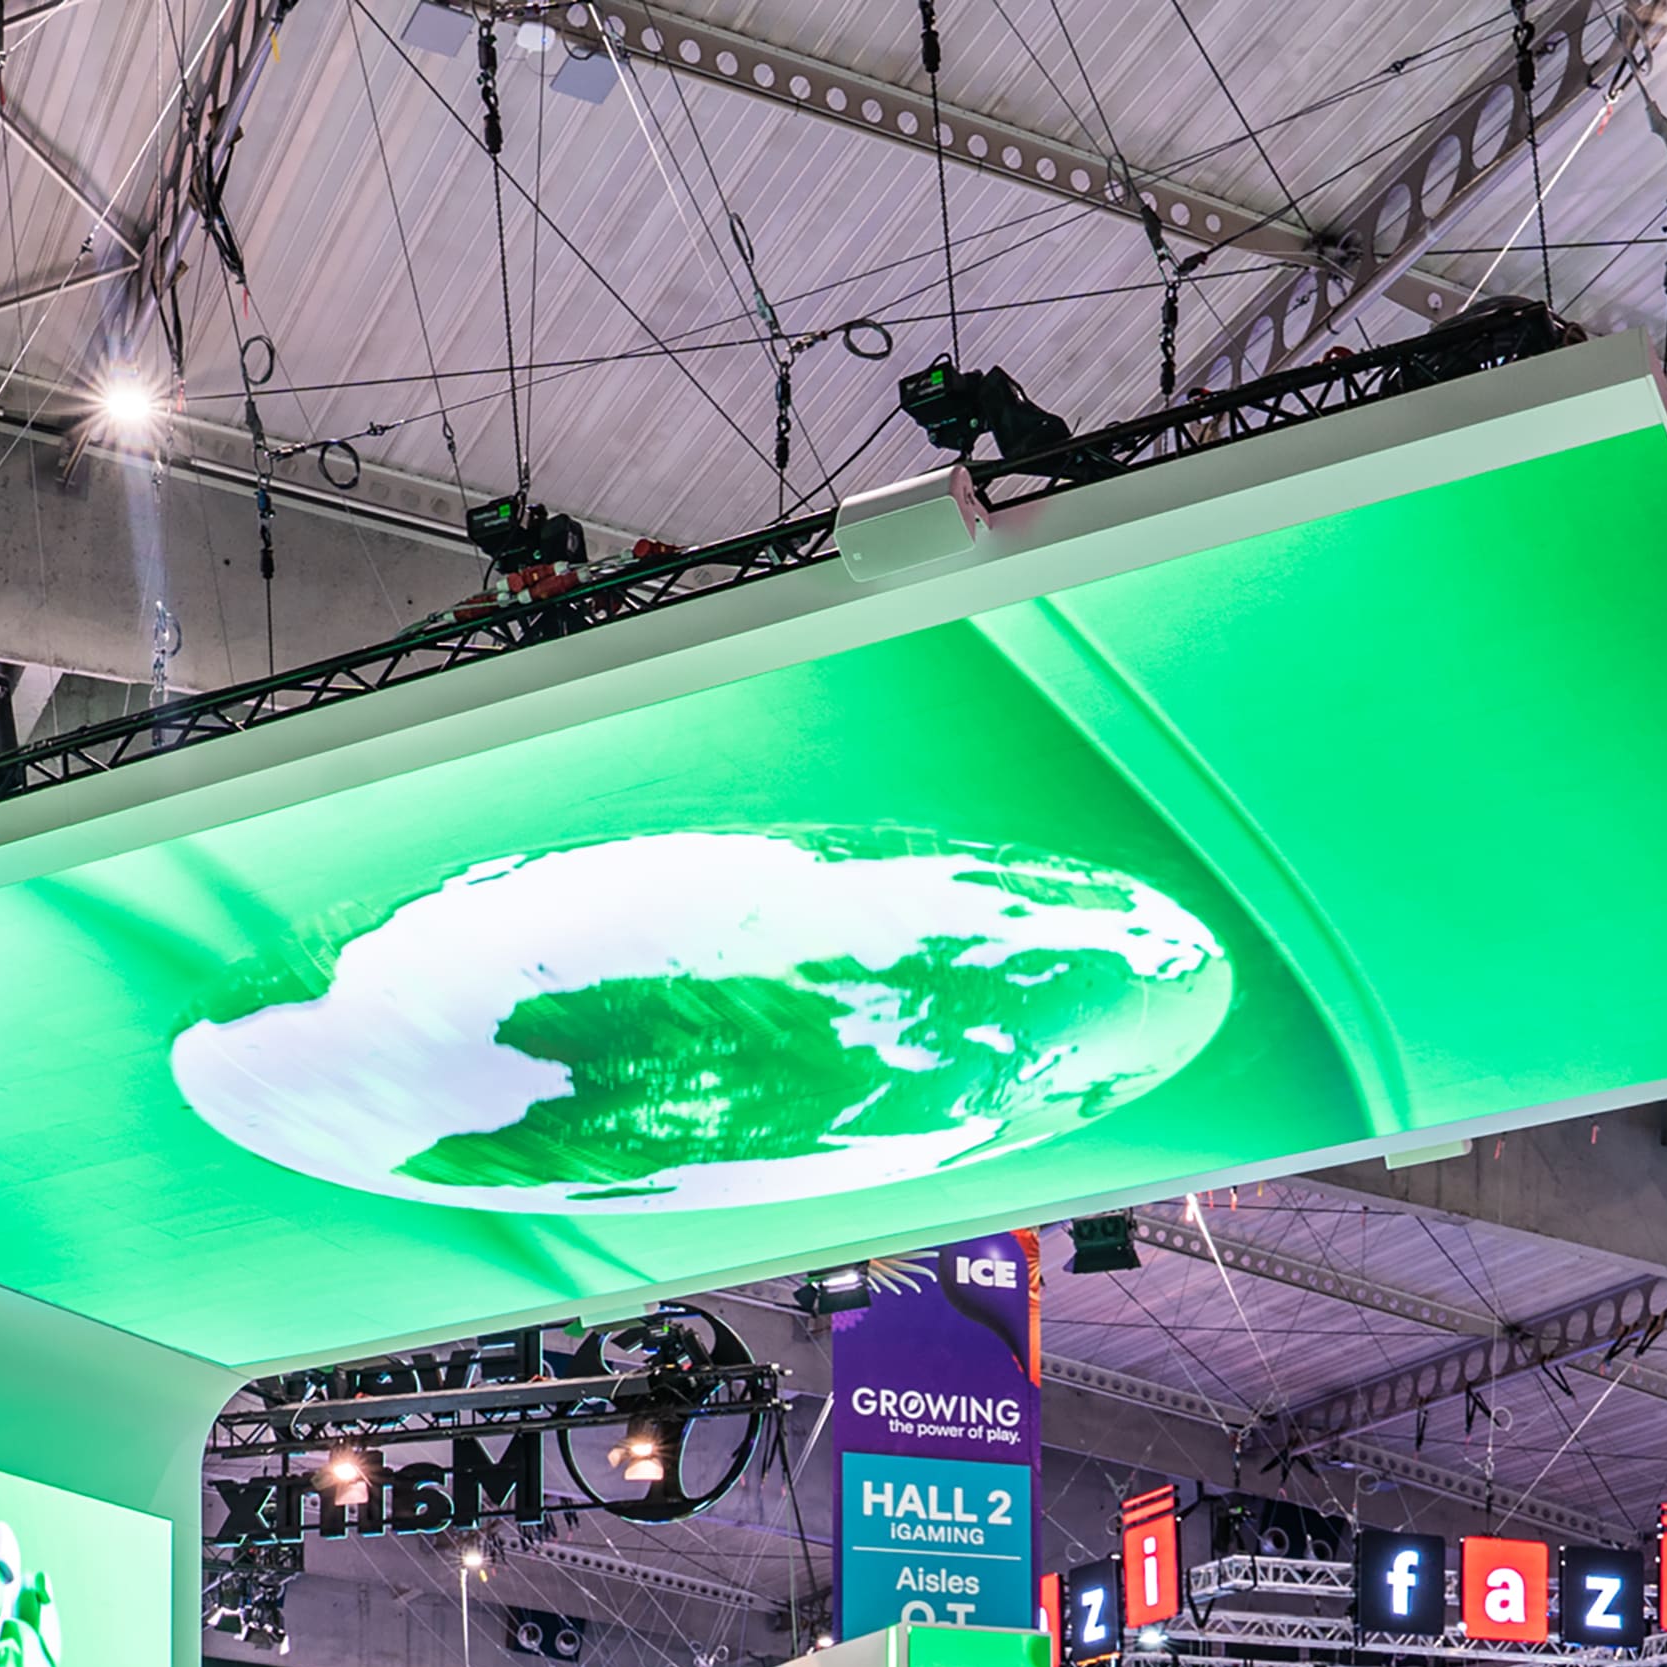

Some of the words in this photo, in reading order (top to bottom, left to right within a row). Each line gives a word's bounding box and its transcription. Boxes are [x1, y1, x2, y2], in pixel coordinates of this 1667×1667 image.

[956, 1256, 1017, 1289] ICE
[852, 1386, 1021, 1427] GROWING
[889, 1418, 914, 1434] the
[917, 1423, 965, 1438] power
[967, 1424, 984, 1439] of
[986, 1427, 1022, 1445] play.
[862, 1480, 978, 1523] HALL
[987, 1489, 1012, 1525] 2
[890, 1522, 985, 1545] iGAMING
[895, 1566, 980, 1595] Aisles
